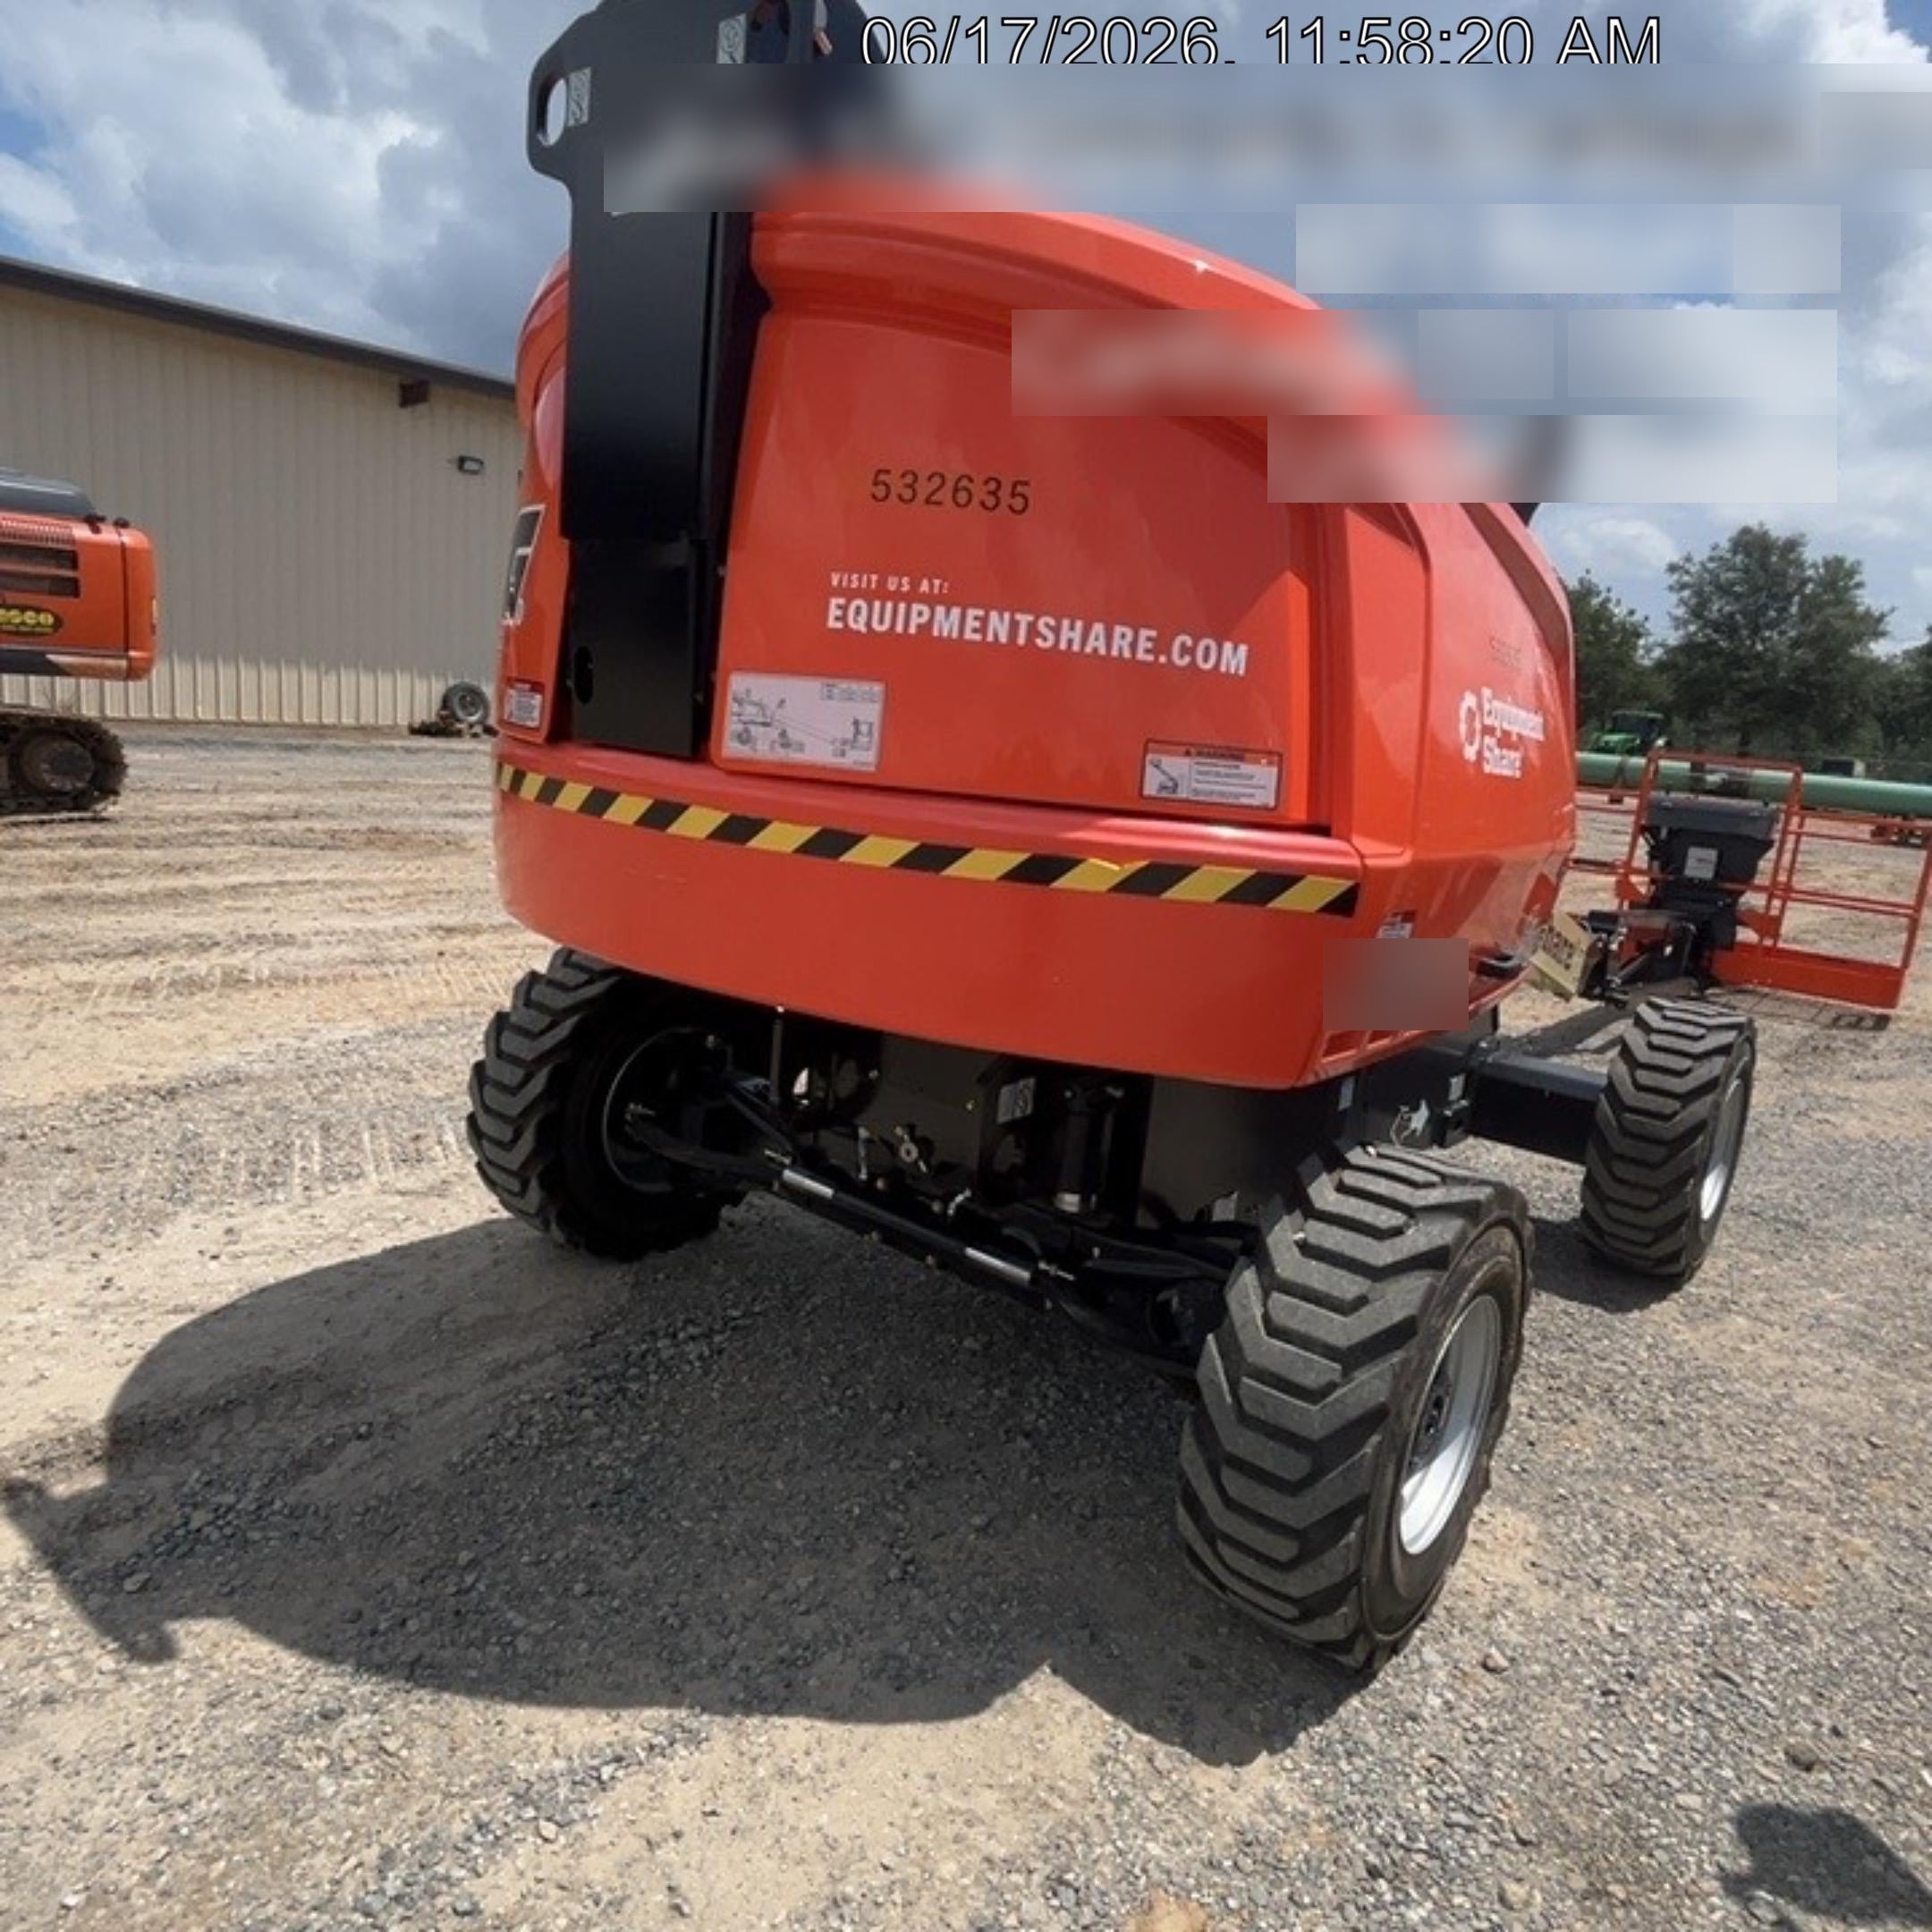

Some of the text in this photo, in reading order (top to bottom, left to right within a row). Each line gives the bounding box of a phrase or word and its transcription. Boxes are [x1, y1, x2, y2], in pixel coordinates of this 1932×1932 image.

[870, 469, 1031, 516] 532635
[830, 572, 949, 595] VISIT US AT:
[826, 597, 1248, 675] EQUIPMENTSHARE.COM
